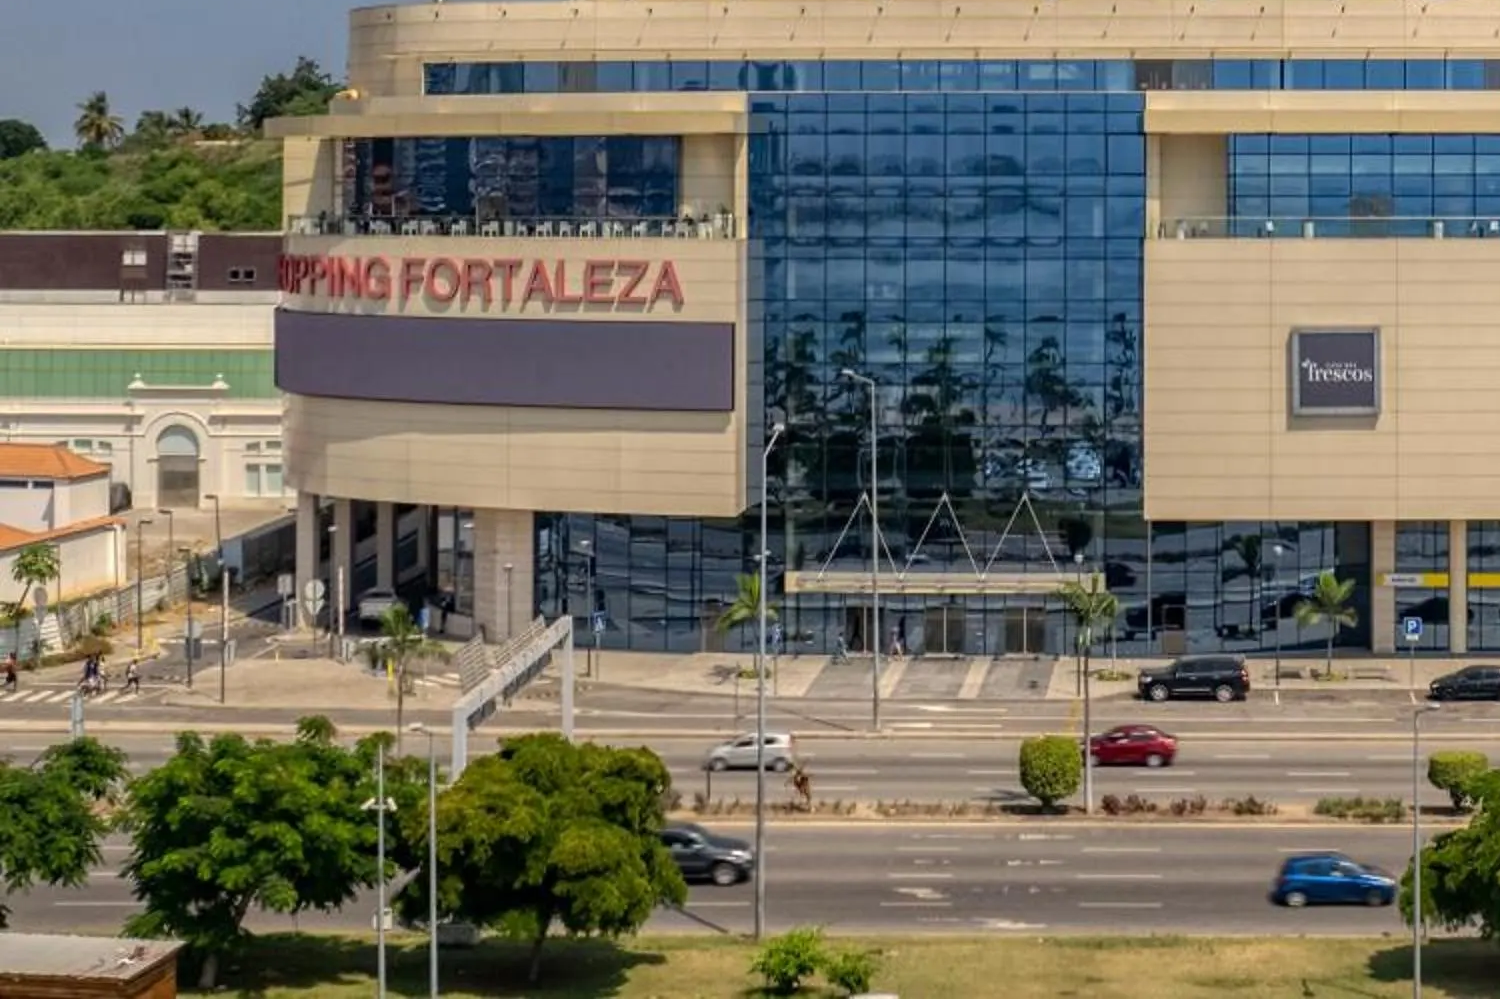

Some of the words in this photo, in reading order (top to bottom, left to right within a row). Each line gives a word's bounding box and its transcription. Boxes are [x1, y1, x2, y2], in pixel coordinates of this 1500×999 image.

[400, 256, 685, 305] FORTALEZA
[1308, 361, 1373, 383] frescos
[1407, 620, 1417, 632] P
